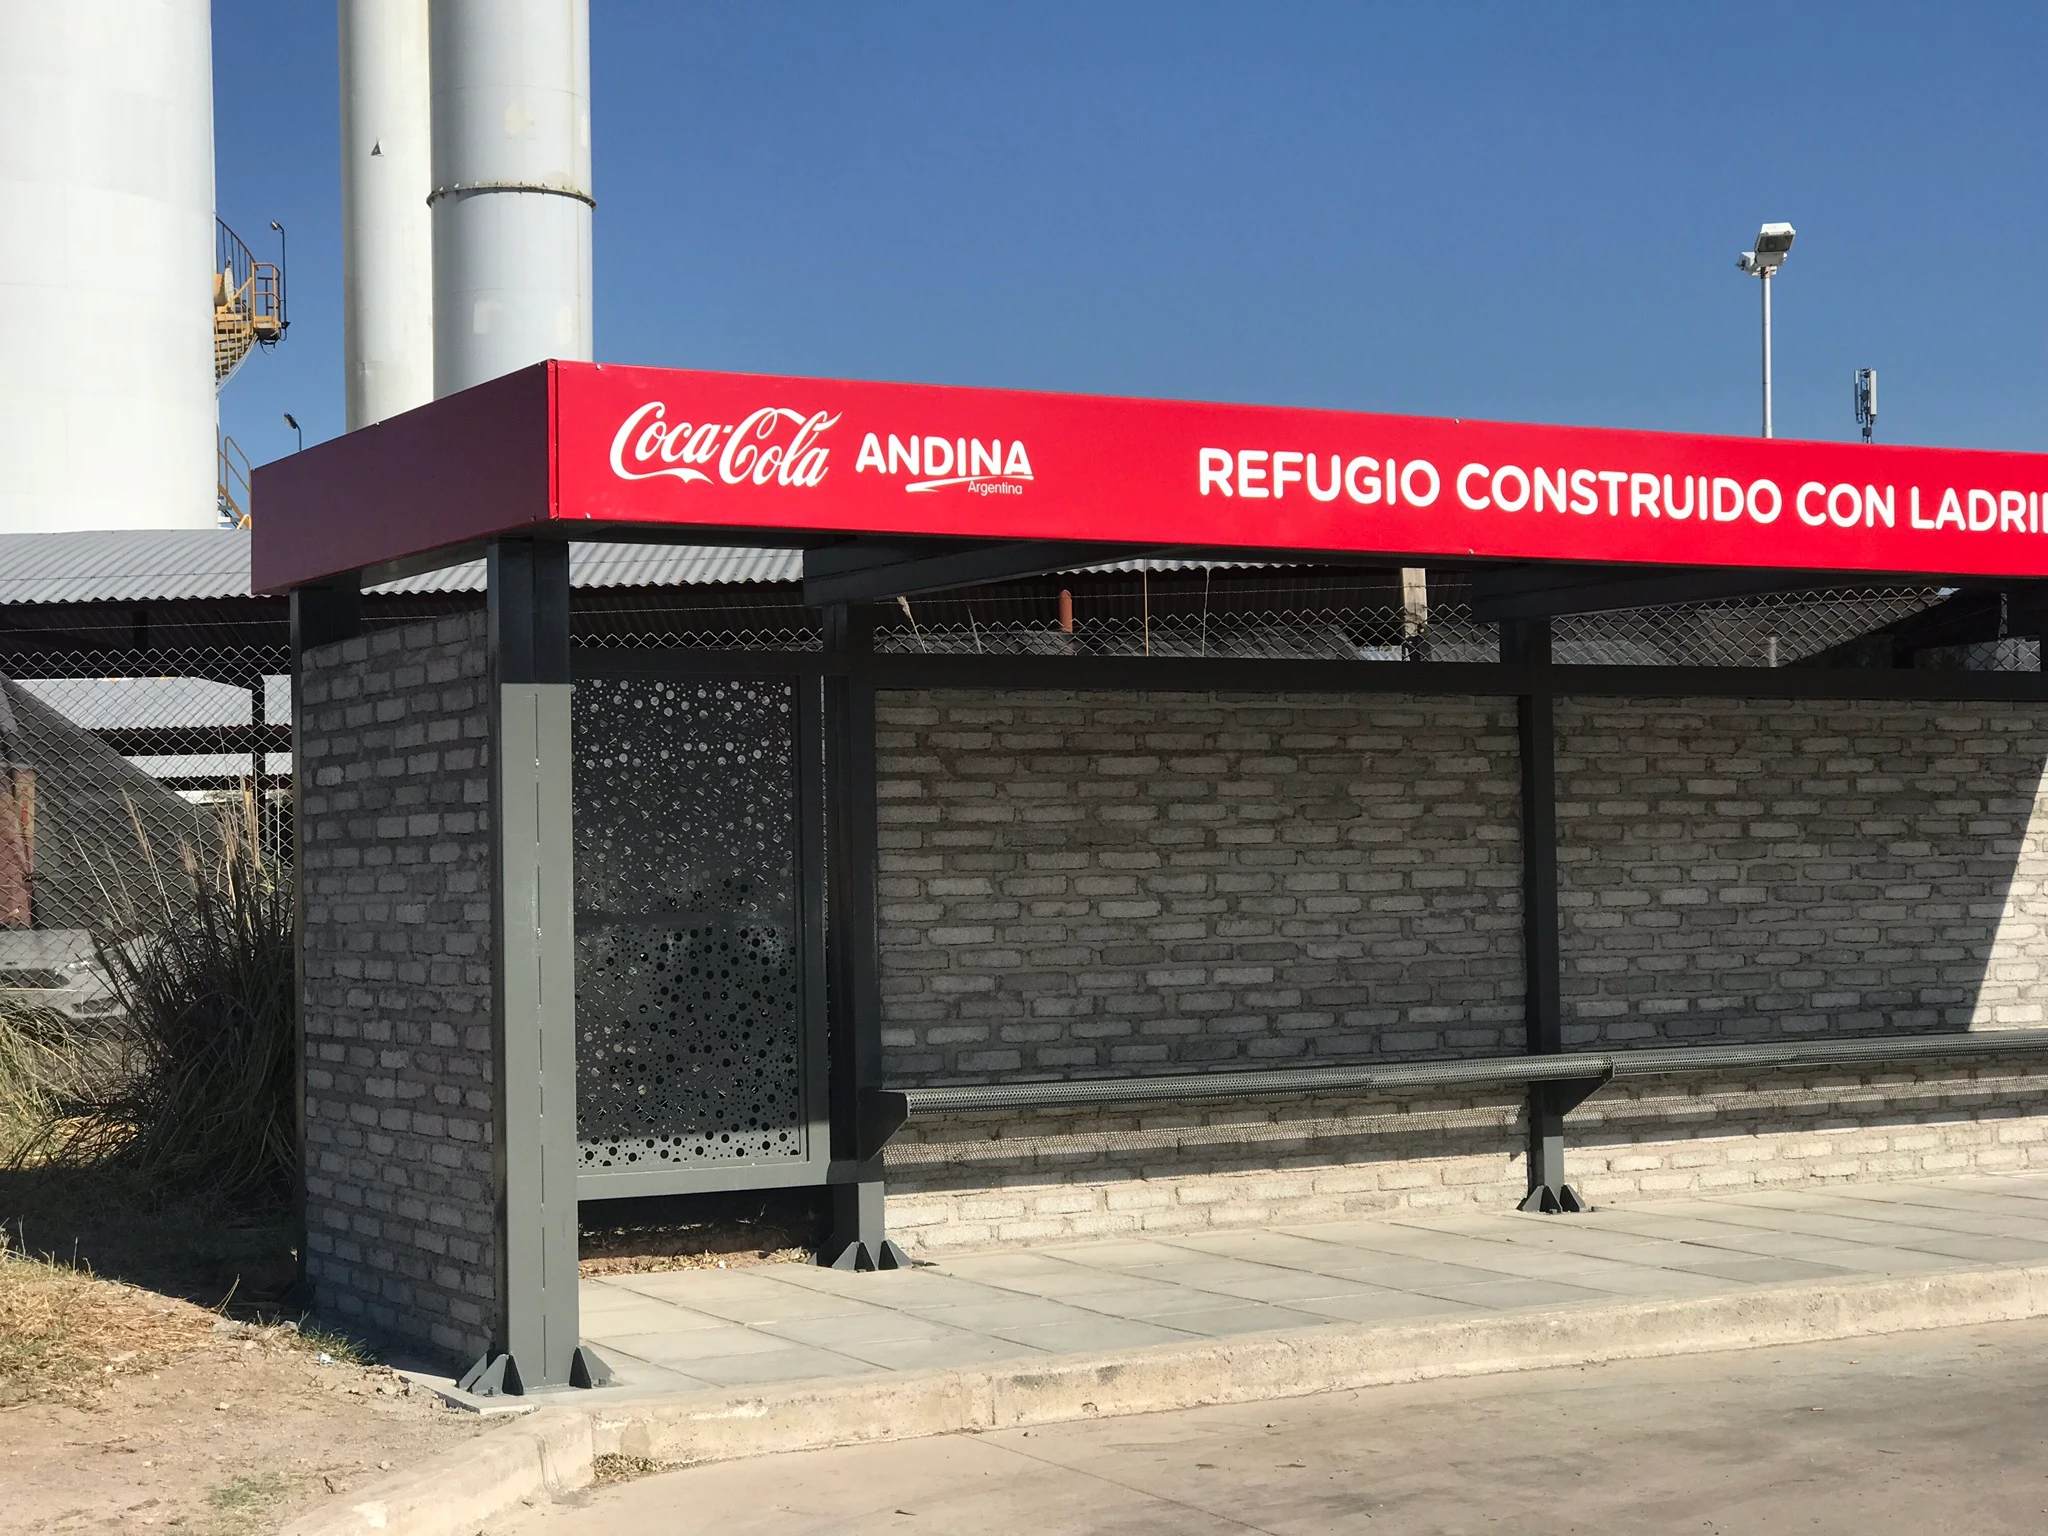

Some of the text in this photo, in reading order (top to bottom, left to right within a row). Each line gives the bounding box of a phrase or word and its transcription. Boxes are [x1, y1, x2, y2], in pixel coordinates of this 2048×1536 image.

[610, 402, 842, 488] Coca-Cola
[856, 433, 1033, 477] ANDINA
[968, 481, 1023, 497] Argentina
[1199, 447, 1441, 508] REFUGIO
[1456, 462, 1783, 525] CONSTRUIDO
[1796, 481, 1895, 528] CON
